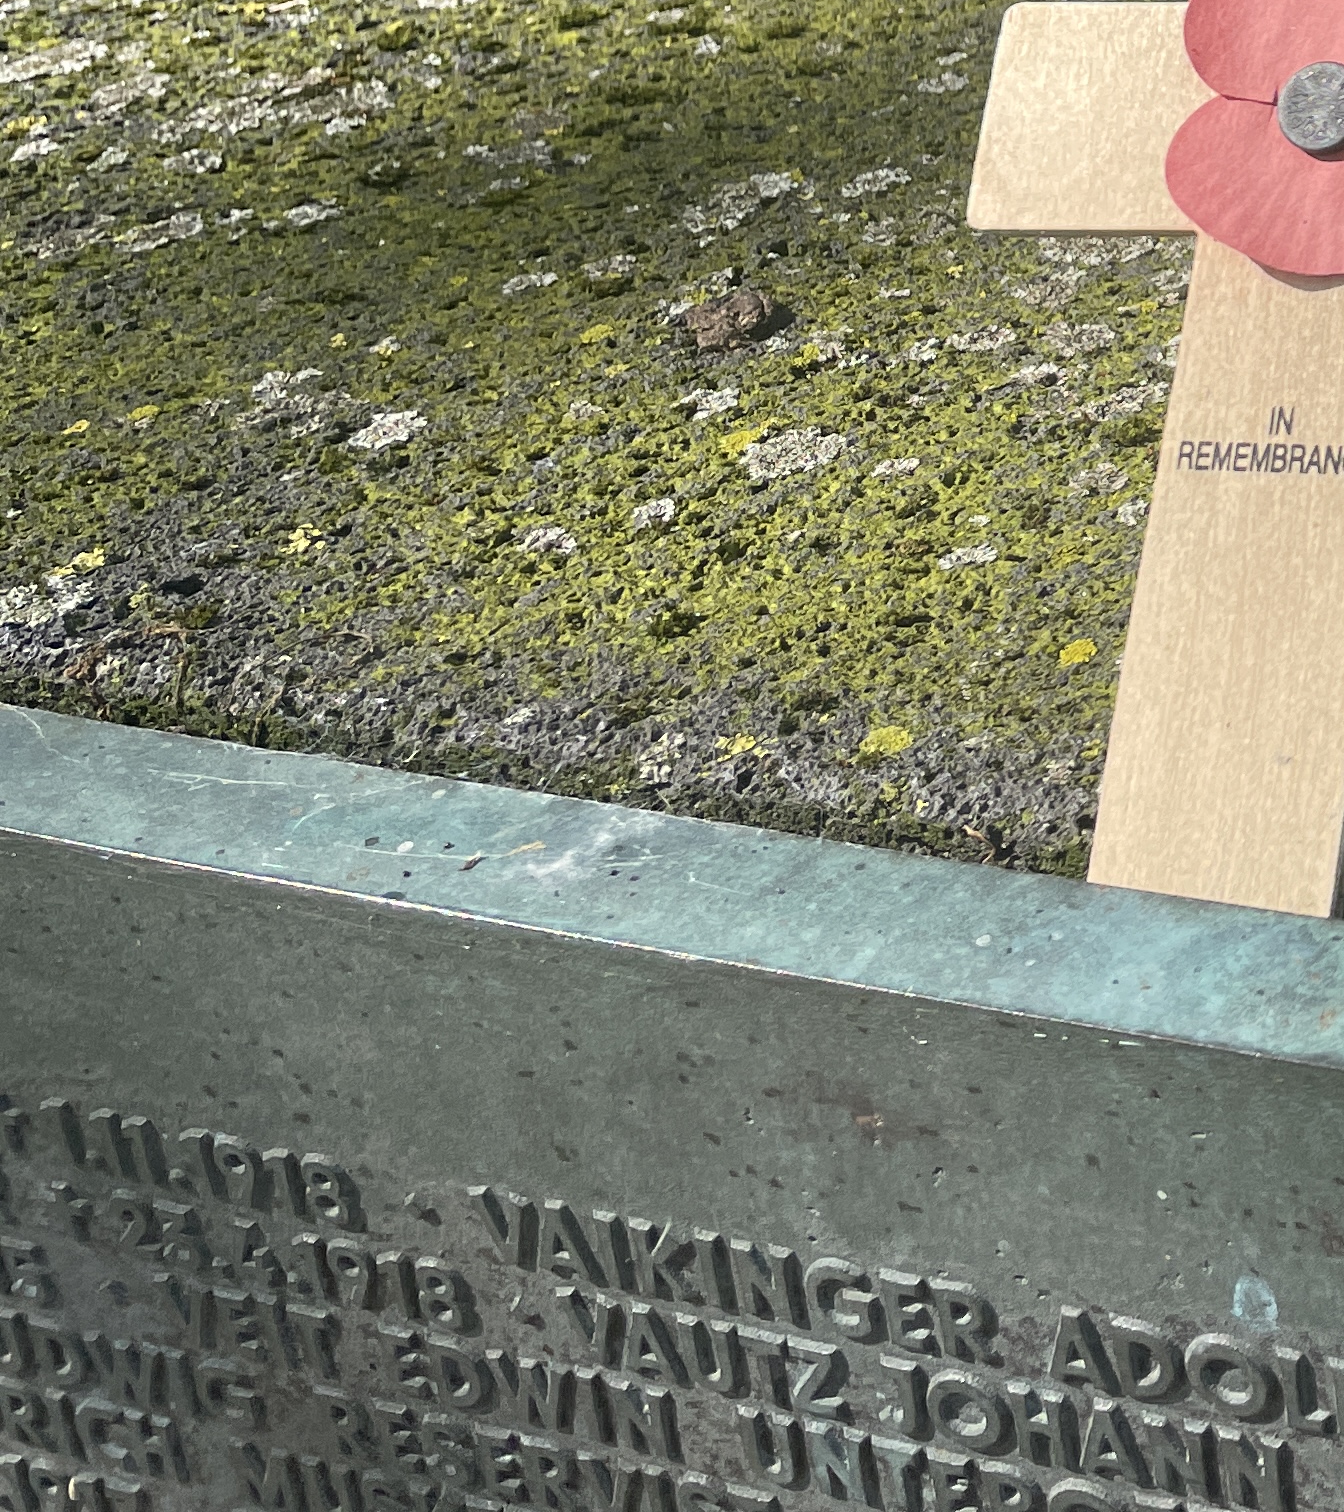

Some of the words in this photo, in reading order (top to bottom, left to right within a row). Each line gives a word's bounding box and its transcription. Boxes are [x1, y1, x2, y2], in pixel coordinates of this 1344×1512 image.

[1268, 406, 1295, 436] IN
[152, 1271, 342, 1383] VEIT
[378, 1323, 686, 1464] EDWIN
[466, 1184, 1003, 1367] VAIKINGER
[554, 1285, 850, 1427] VAUTZ
[878, 1352, 1296, 1512] JOHANN
